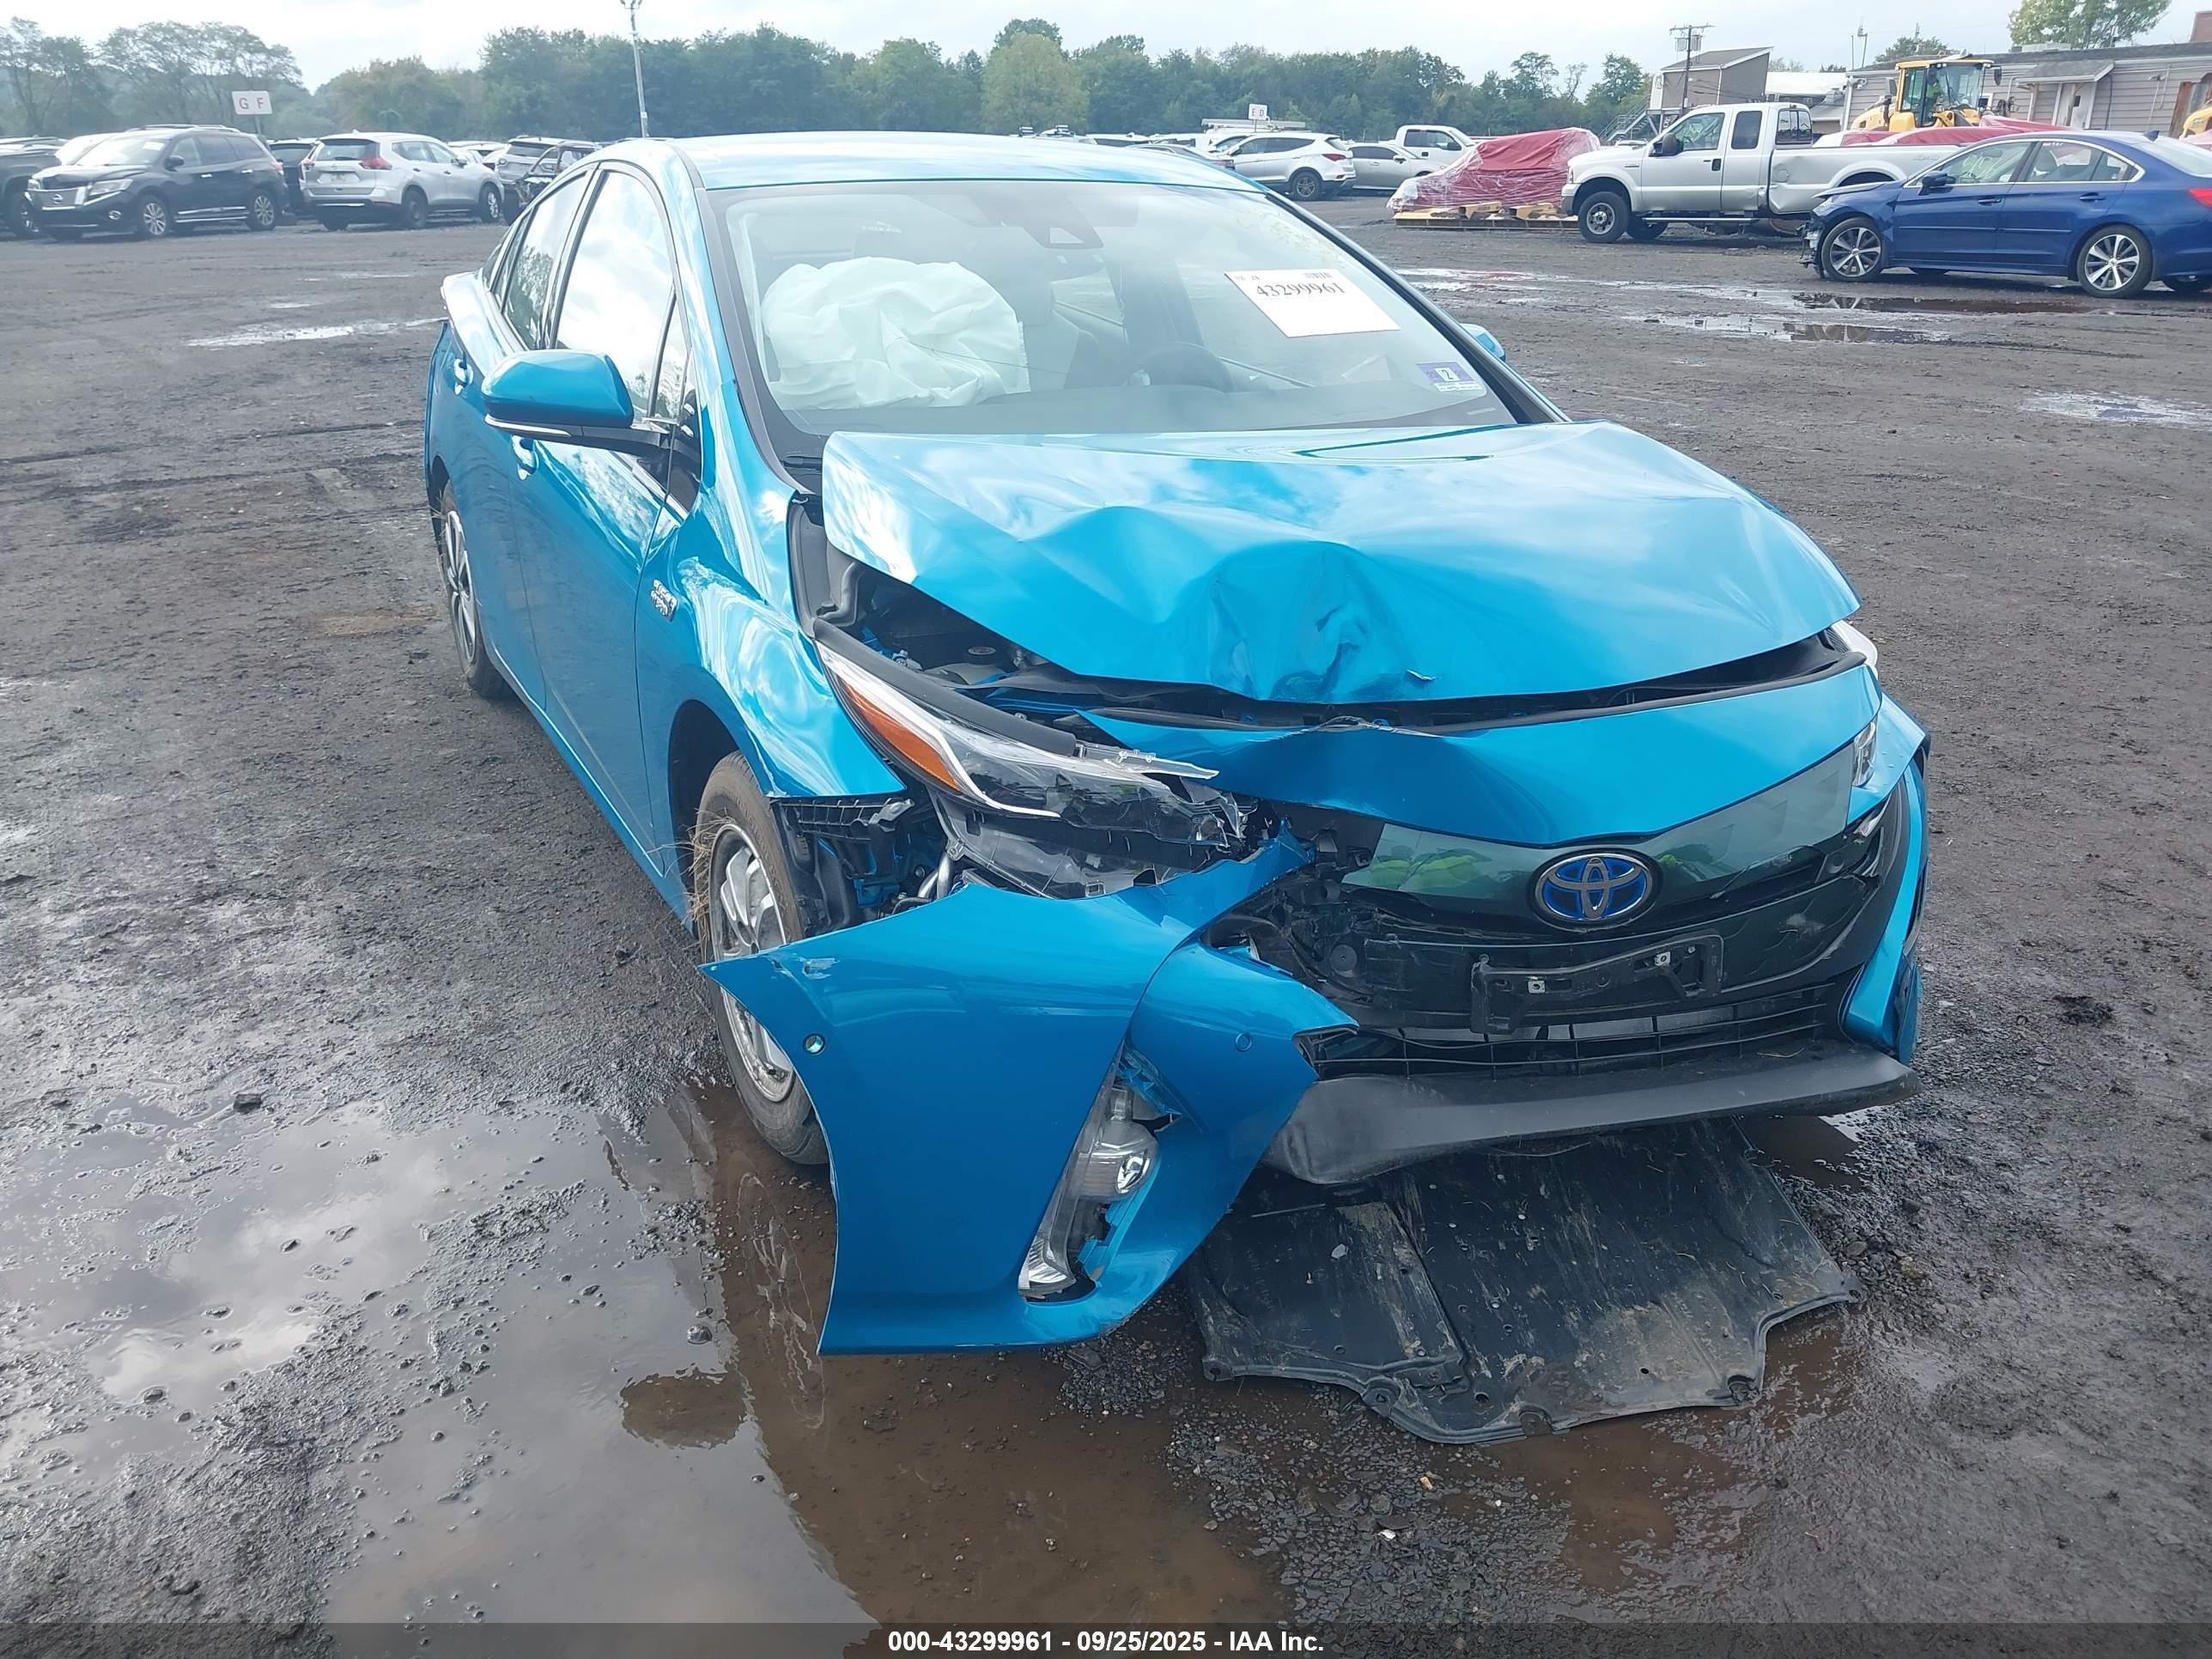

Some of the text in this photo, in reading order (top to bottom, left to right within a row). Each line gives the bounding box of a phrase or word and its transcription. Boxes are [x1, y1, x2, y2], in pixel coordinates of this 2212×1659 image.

[239, 97, 264, 110] G F
[1251, 108, 1265, 118] E D
[1256, 283, 1346, 297] 43299961
